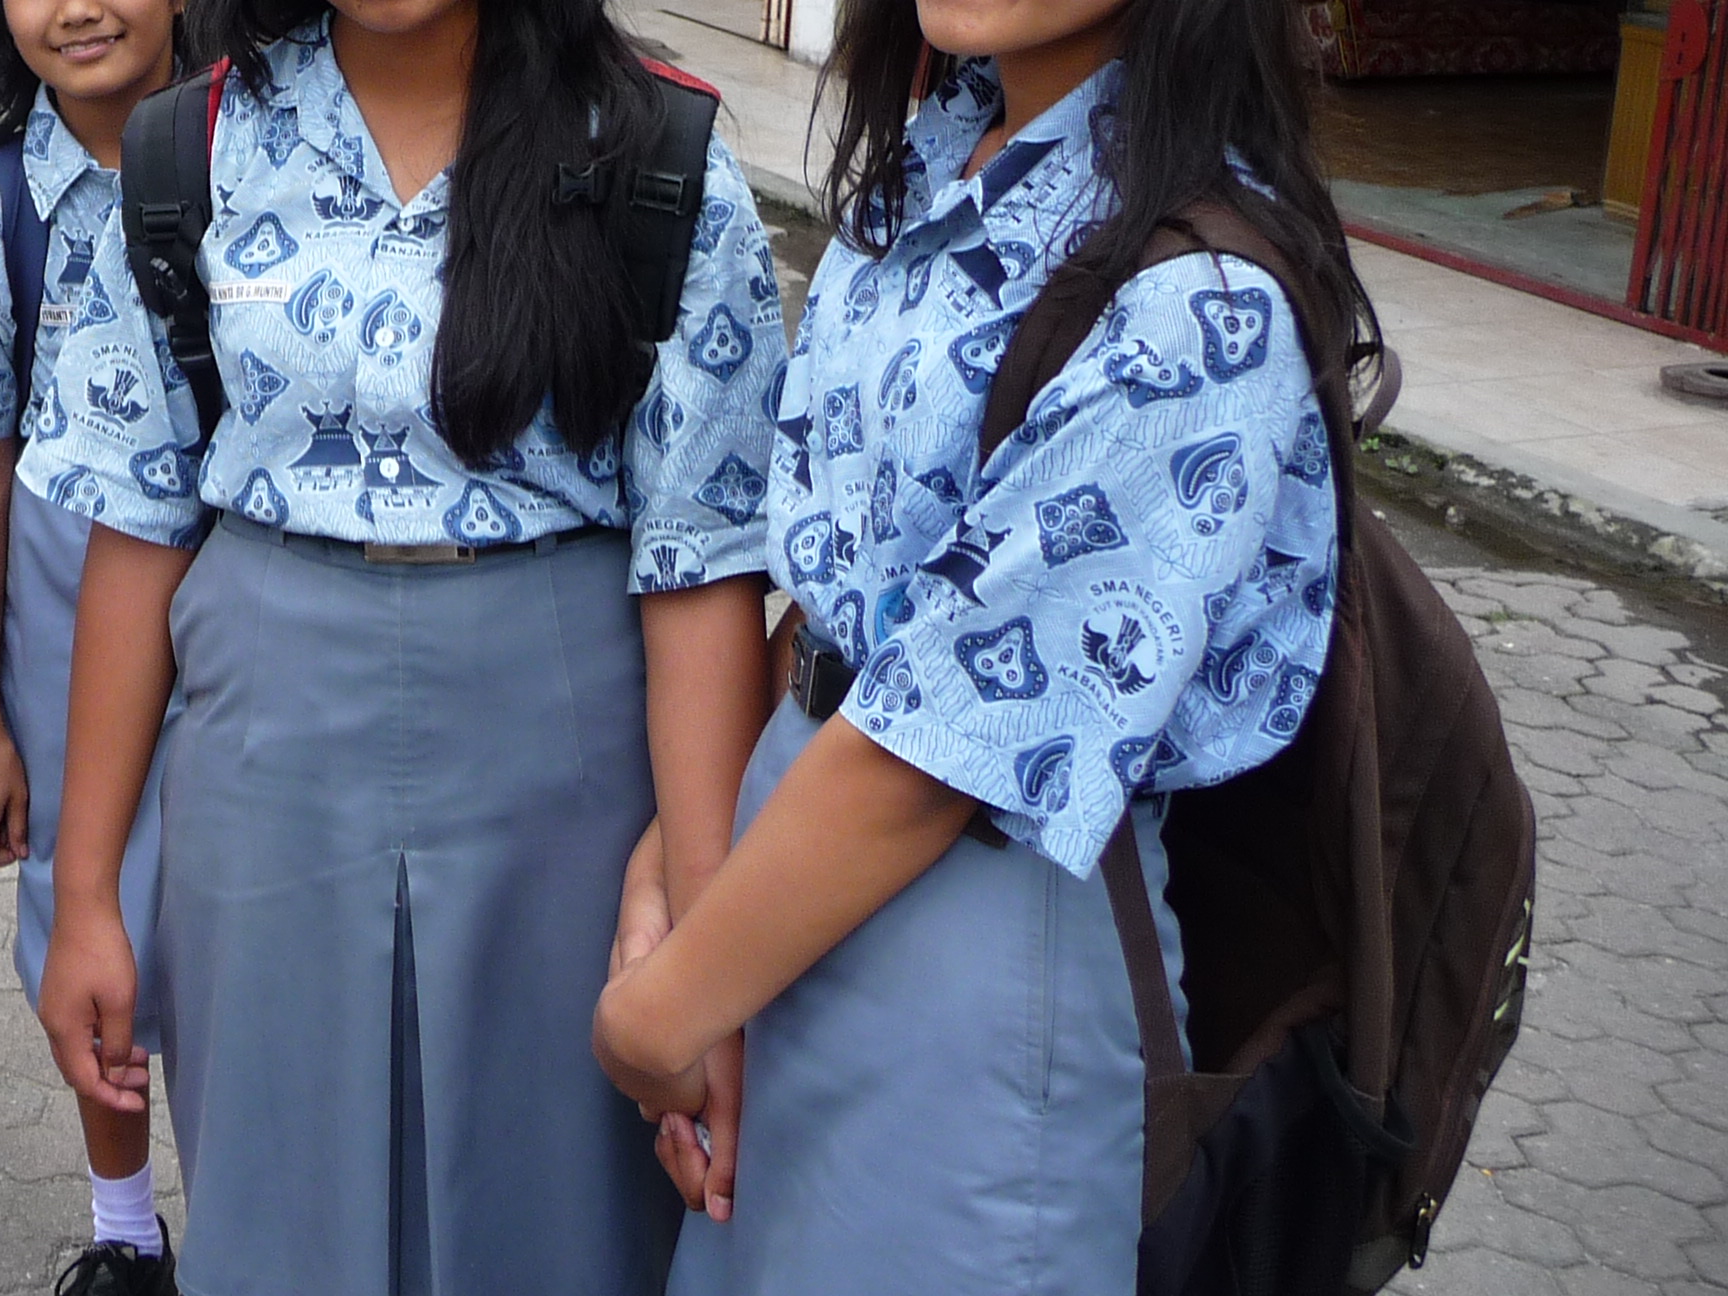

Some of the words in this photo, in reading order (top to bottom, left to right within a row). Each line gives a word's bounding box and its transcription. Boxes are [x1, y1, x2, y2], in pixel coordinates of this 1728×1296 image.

[92, 344, 119, 359] SMA
[73, 412, 137, 446] KABANJAHE
[646, 519, 700, 537] NEGERI
[1093, 601, 1111, 614] TUT
[1090, 580, 1129, 596] SMA
[1135, 584, 1183, 642] NEGERI
[1173, 648, 1184, 656] 2
